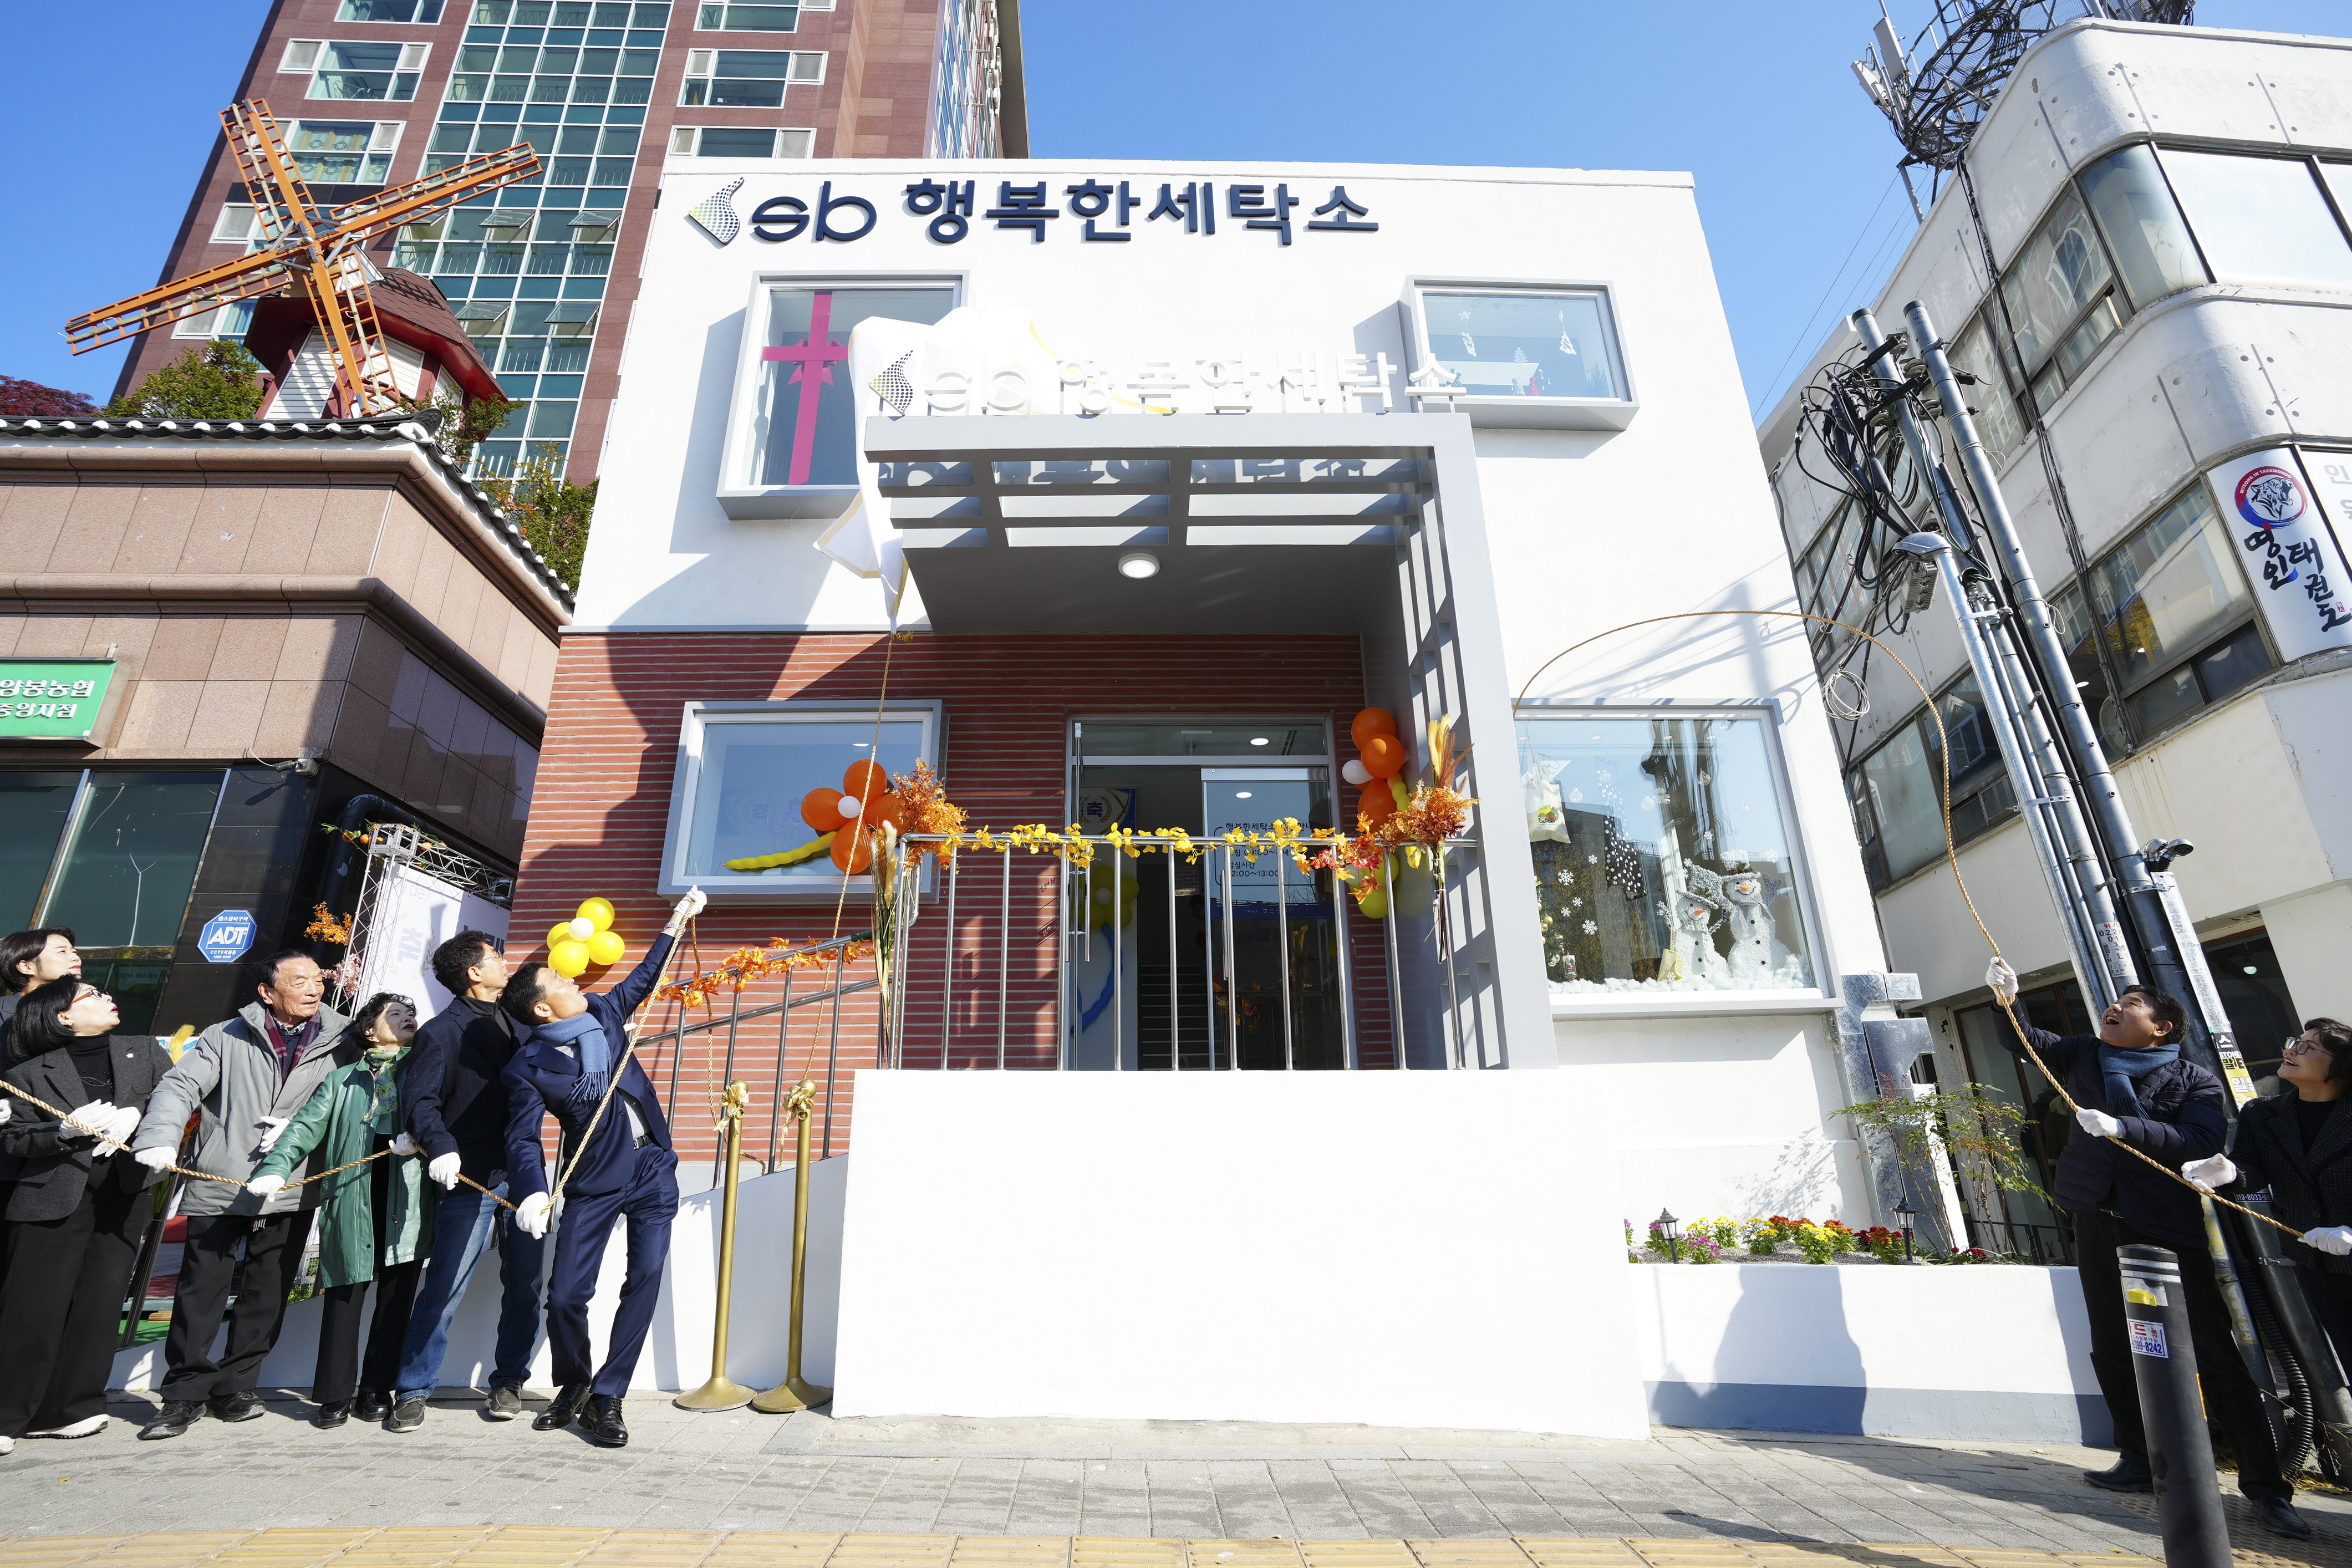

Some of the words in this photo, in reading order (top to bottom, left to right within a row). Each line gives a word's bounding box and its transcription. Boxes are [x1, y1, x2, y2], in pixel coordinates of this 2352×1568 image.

[752, 181, 877, 242] sb
[907, 178, 1379, 246] 행복한세탁소
[2239, 475, 2254, 494] MYEONG
[2260, 469, 2292, 478] TAEKWONDO
[2243, 522, 2299, 591] 명인
[2285, 537, 2352, 632] 태권도
[208, 926, 248, 945] ADT
